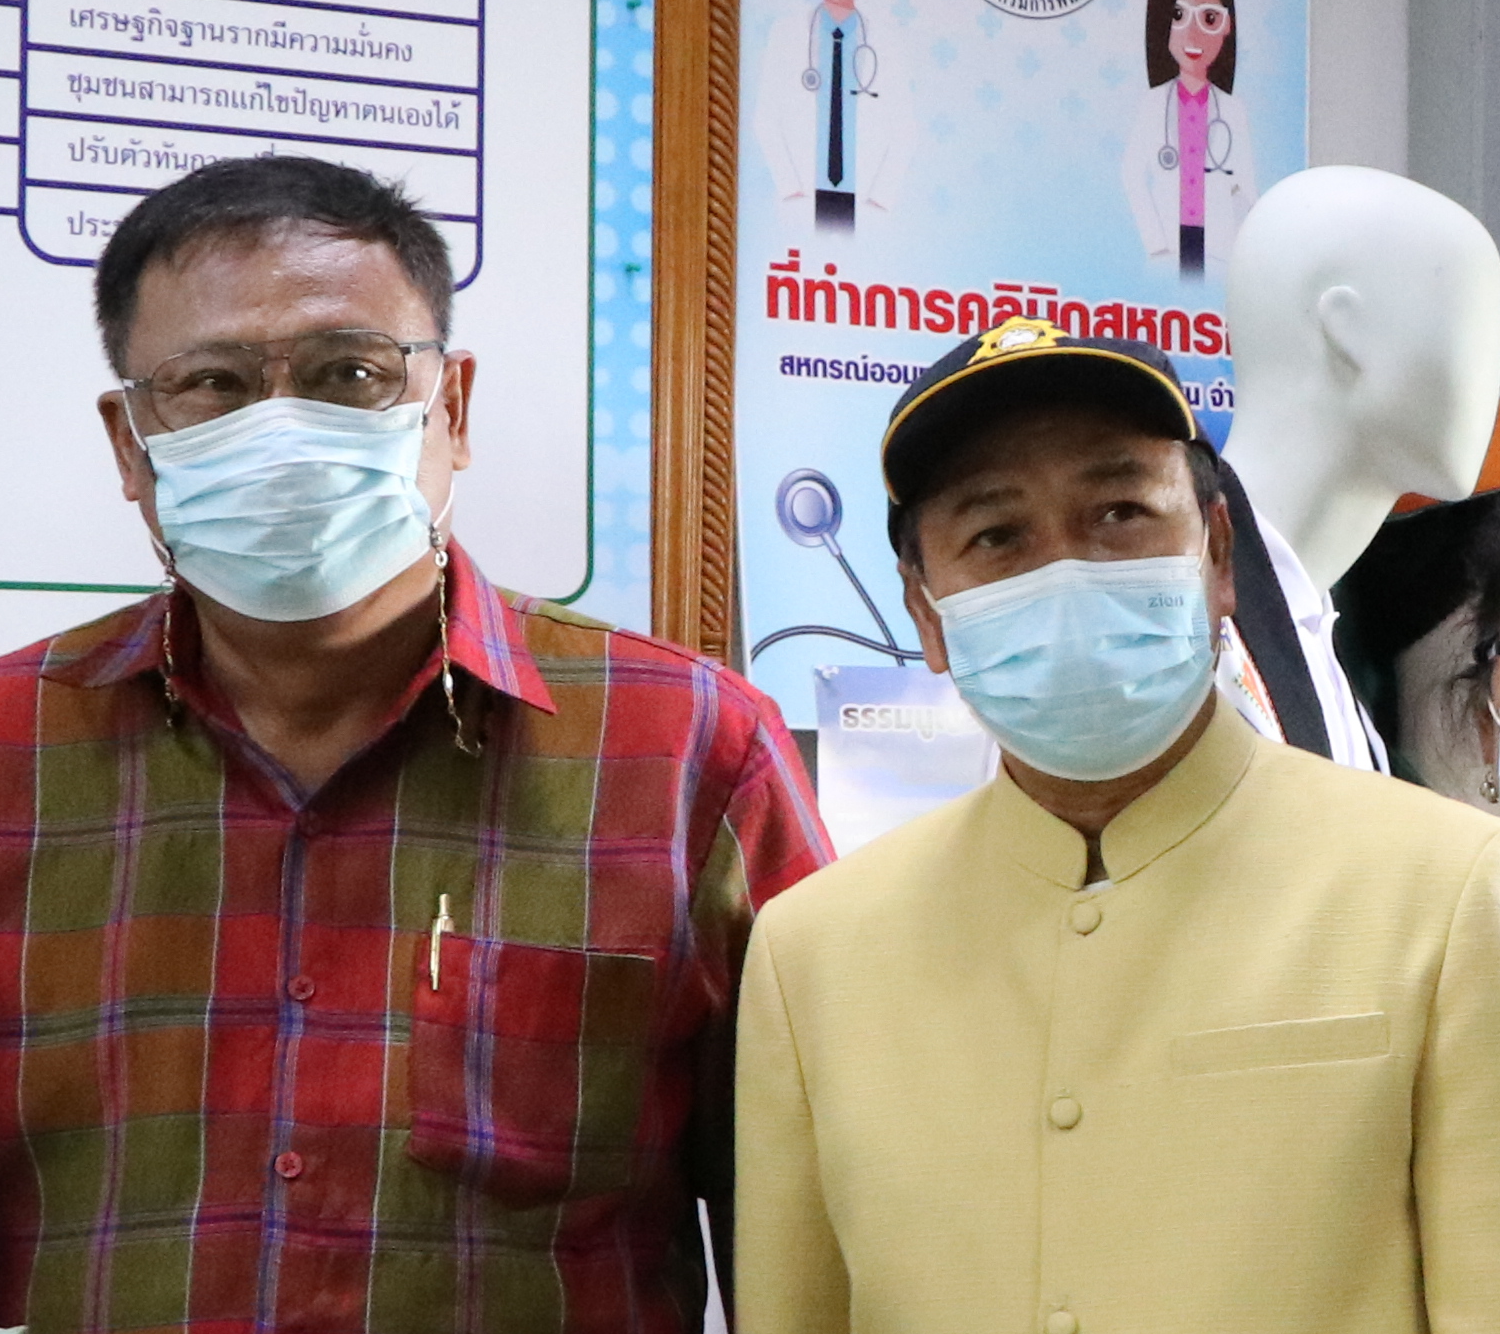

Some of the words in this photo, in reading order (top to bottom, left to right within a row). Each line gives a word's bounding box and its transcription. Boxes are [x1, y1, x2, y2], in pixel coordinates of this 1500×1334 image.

[69, 6, 413, 64] เศรษฐกิจฐานรากมีความมั่นคง
[67, 72, 461, 131] ชุมชนสามารถแก้ไขปัญหาตนเองได้
[766, 248, 1232, 357] ที่ทำการคลินิกสหกร
[1147, 592, 1184, 609] zion
